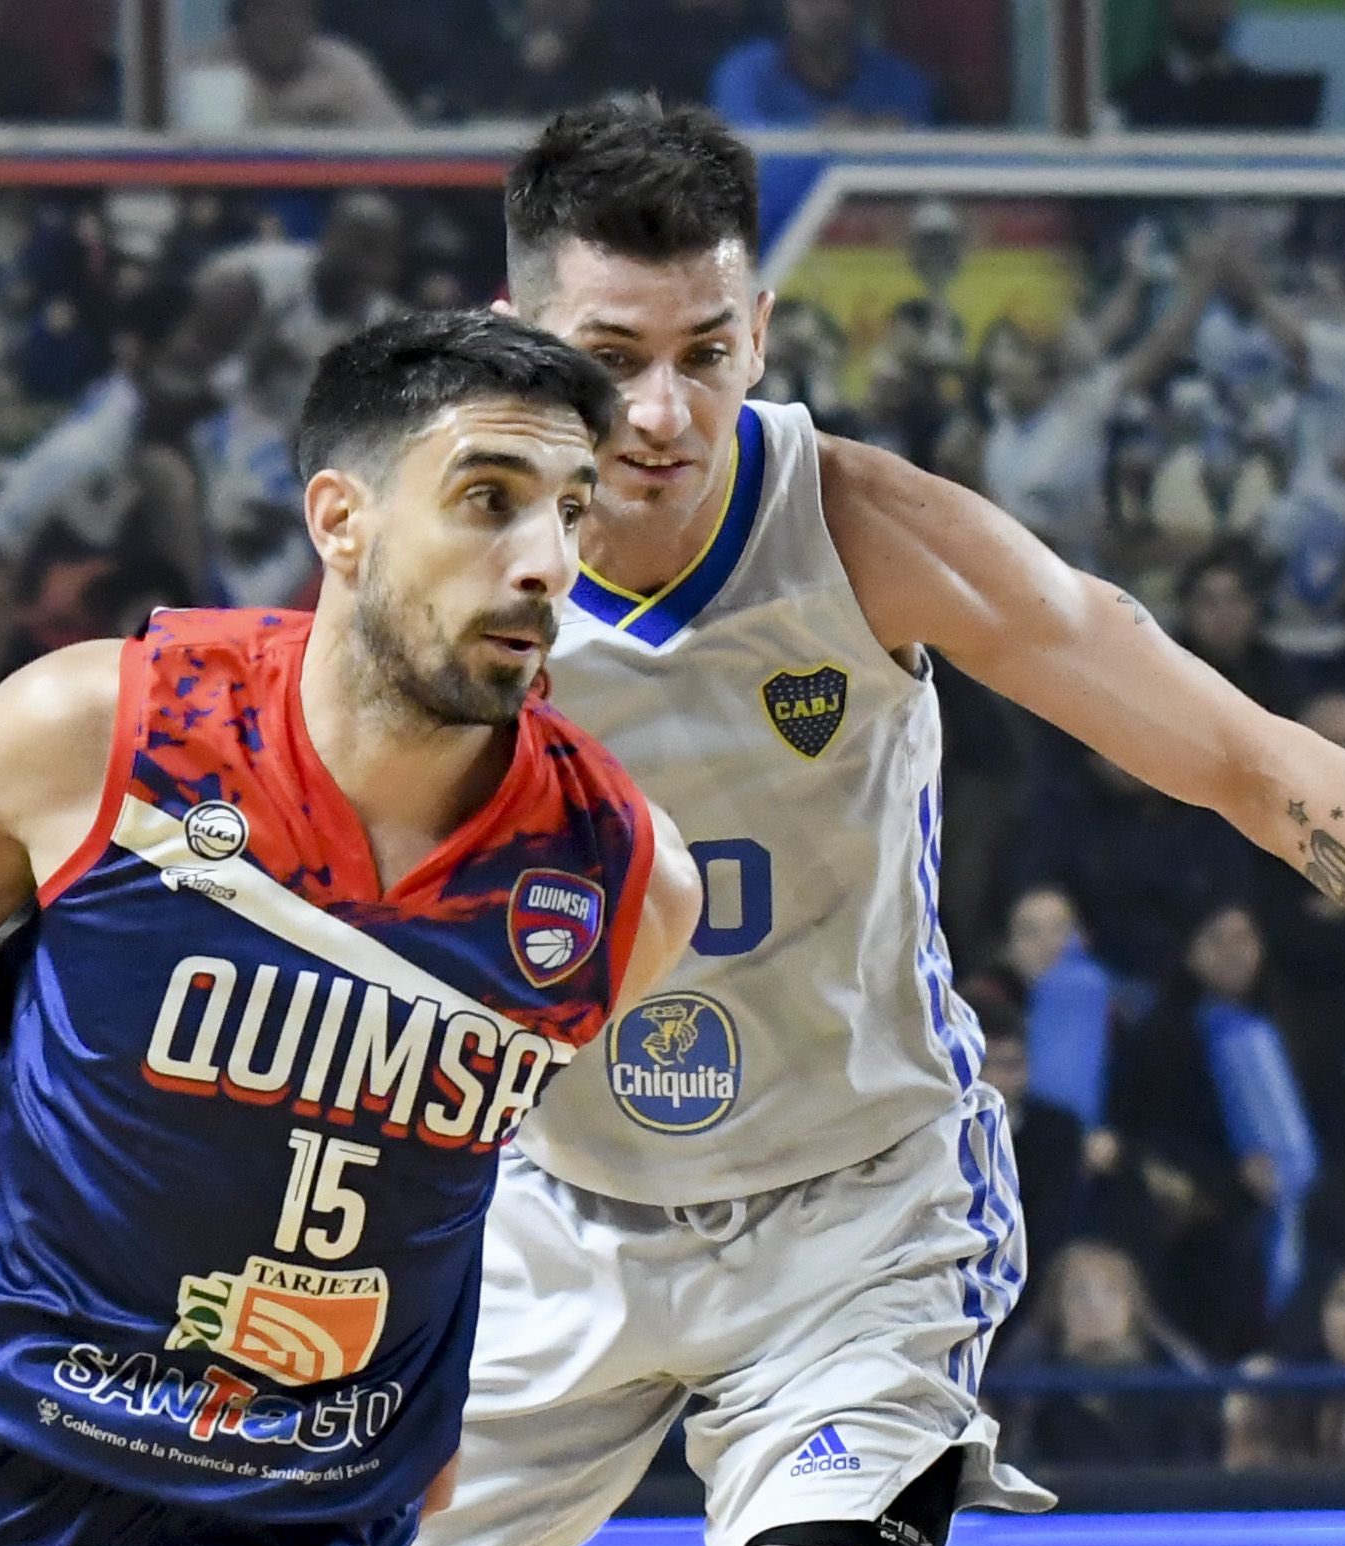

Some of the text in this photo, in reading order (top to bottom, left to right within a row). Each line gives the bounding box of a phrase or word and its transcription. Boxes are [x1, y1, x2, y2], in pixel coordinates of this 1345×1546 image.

[774, 693, 839, 720] CABJ
[527, 884, 591, 921] QUIMSA
[142, 956, 553, 1154] QUIMSA
[612, 1063, 734, 1108] Chiquita
[273, 1127, 381, 1260] 15
[254, 1261, 382, 1297] TARJETA
[61, 1413, 128, 1449] Gobierno
[129, 1436, 150, 1454] de
[152, 1443, 165, 1457] la
[168, 1447, 235, 1475] Provincia
[237, 1461, 257, 1477] de
[260, 1465, 322, 1485] Santiago
[323, 1466, 343, 1481] del
[790, 1455, 861, 1477] adidas
